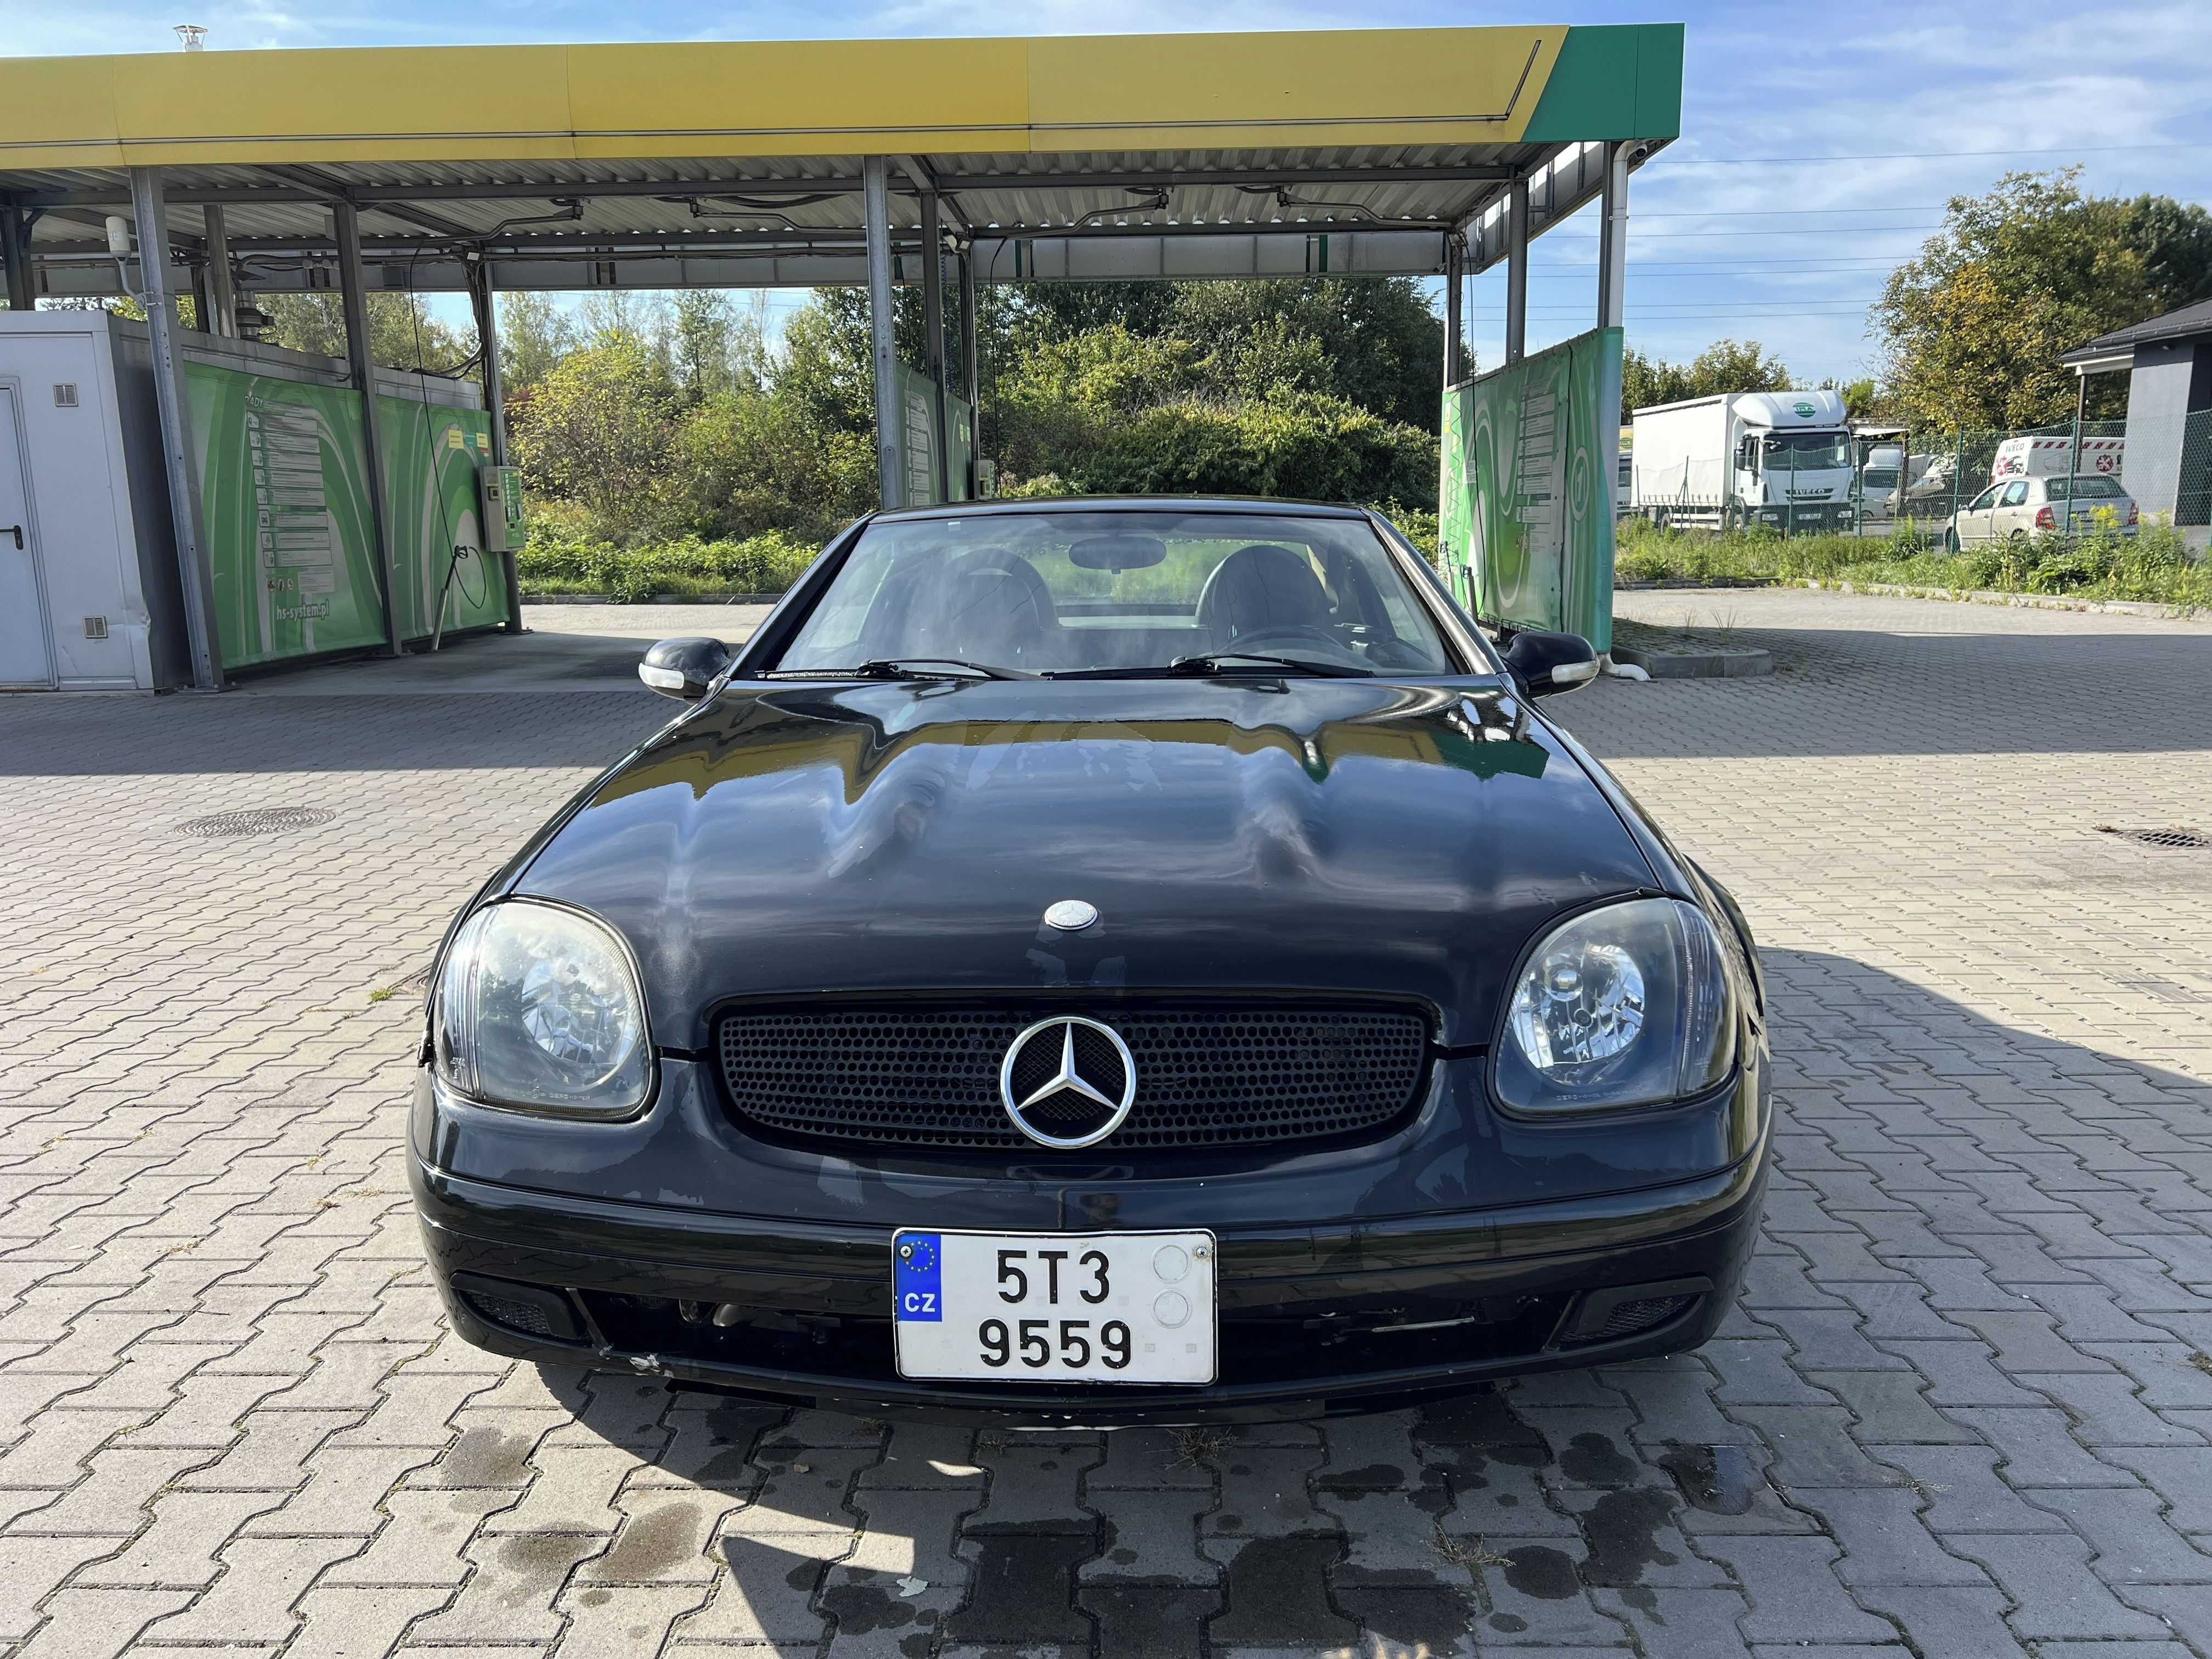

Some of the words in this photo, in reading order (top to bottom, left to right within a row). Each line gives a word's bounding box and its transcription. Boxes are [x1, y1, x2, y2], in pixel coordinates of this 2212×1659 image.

[2006, 443, 2024, 452] IVECO
[276, 600, 329, 622] hs-system.pl
[997, 1250, 1109, 1304] 5T3
[905, 1293, 935, 1312] CZ
[979, 1318, 1131, 1369] 9559
